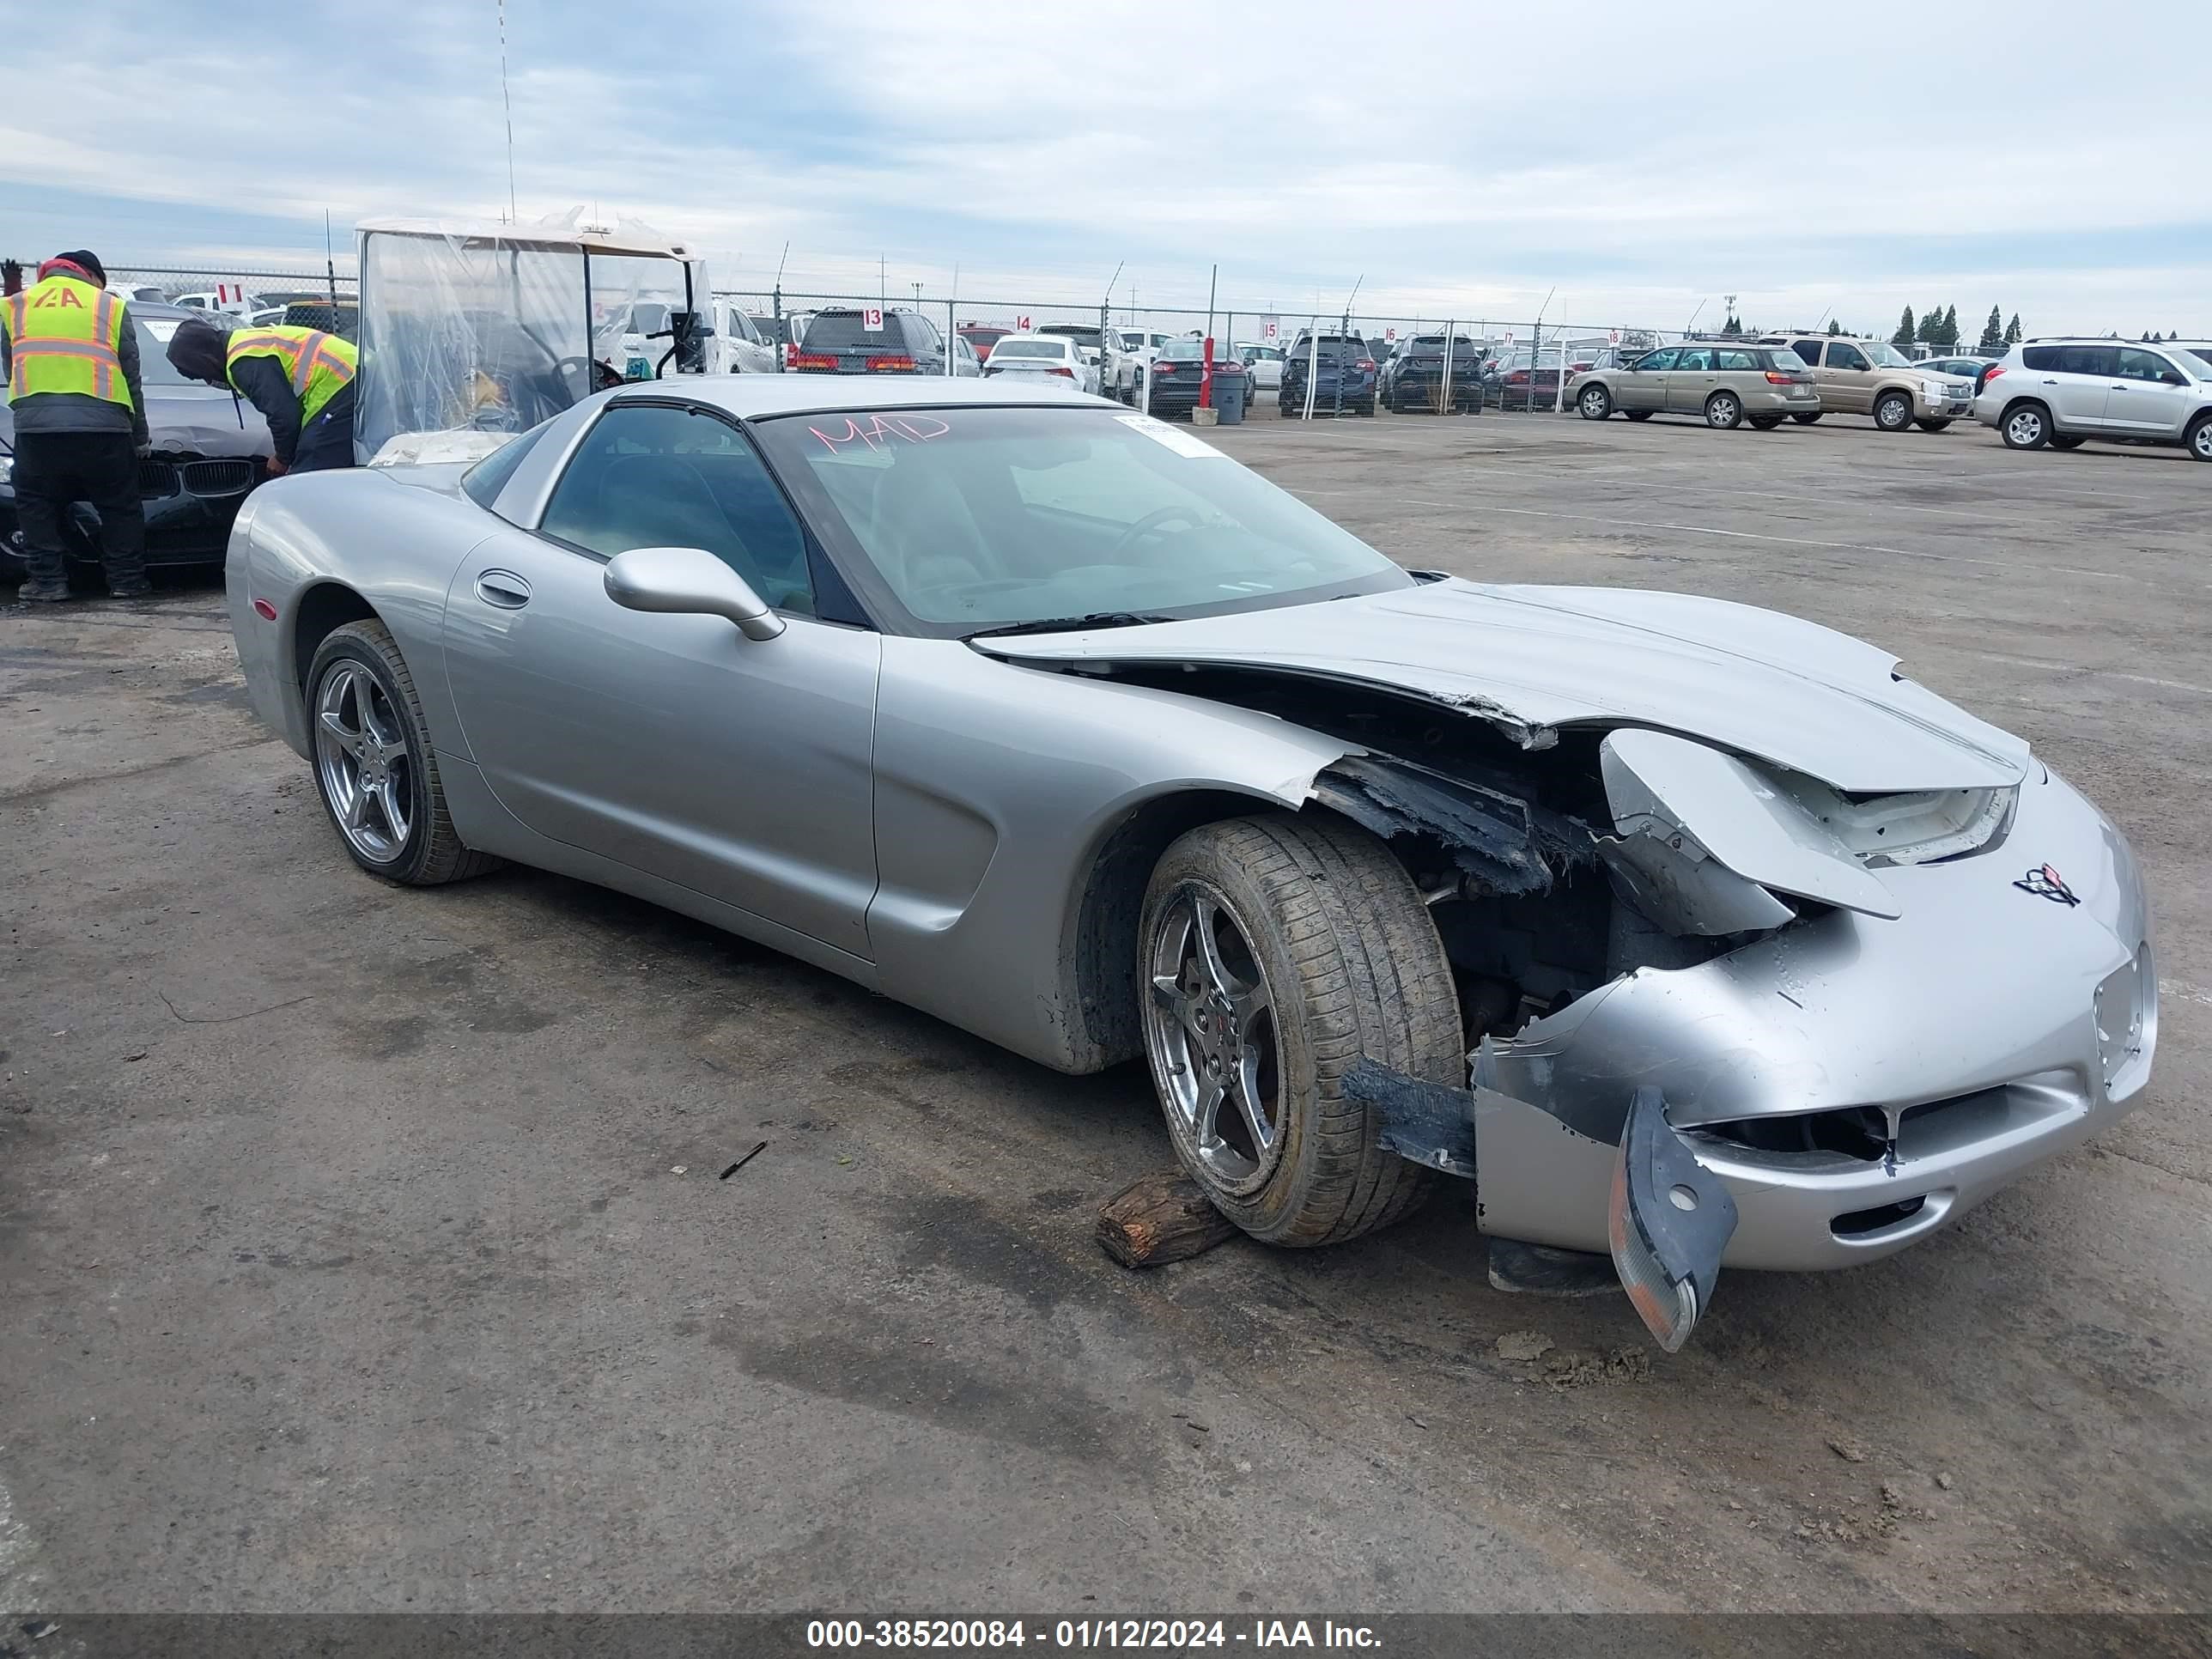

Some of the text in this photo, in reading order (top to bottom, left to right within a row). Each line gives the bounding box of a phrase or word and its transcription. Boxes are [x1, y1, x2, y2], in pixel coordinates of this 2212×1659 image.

[866, 310, 881, 325] 13
[1017, 316, 1030, 331] 14
[1265, 324, 1276, 337] 15
[1385, 328, 1395, 341] 16
[1504, 332, 1513, 343] 17
[1609, 332, 1619, 343] 18
[808, 414, 951, 455] MAD
